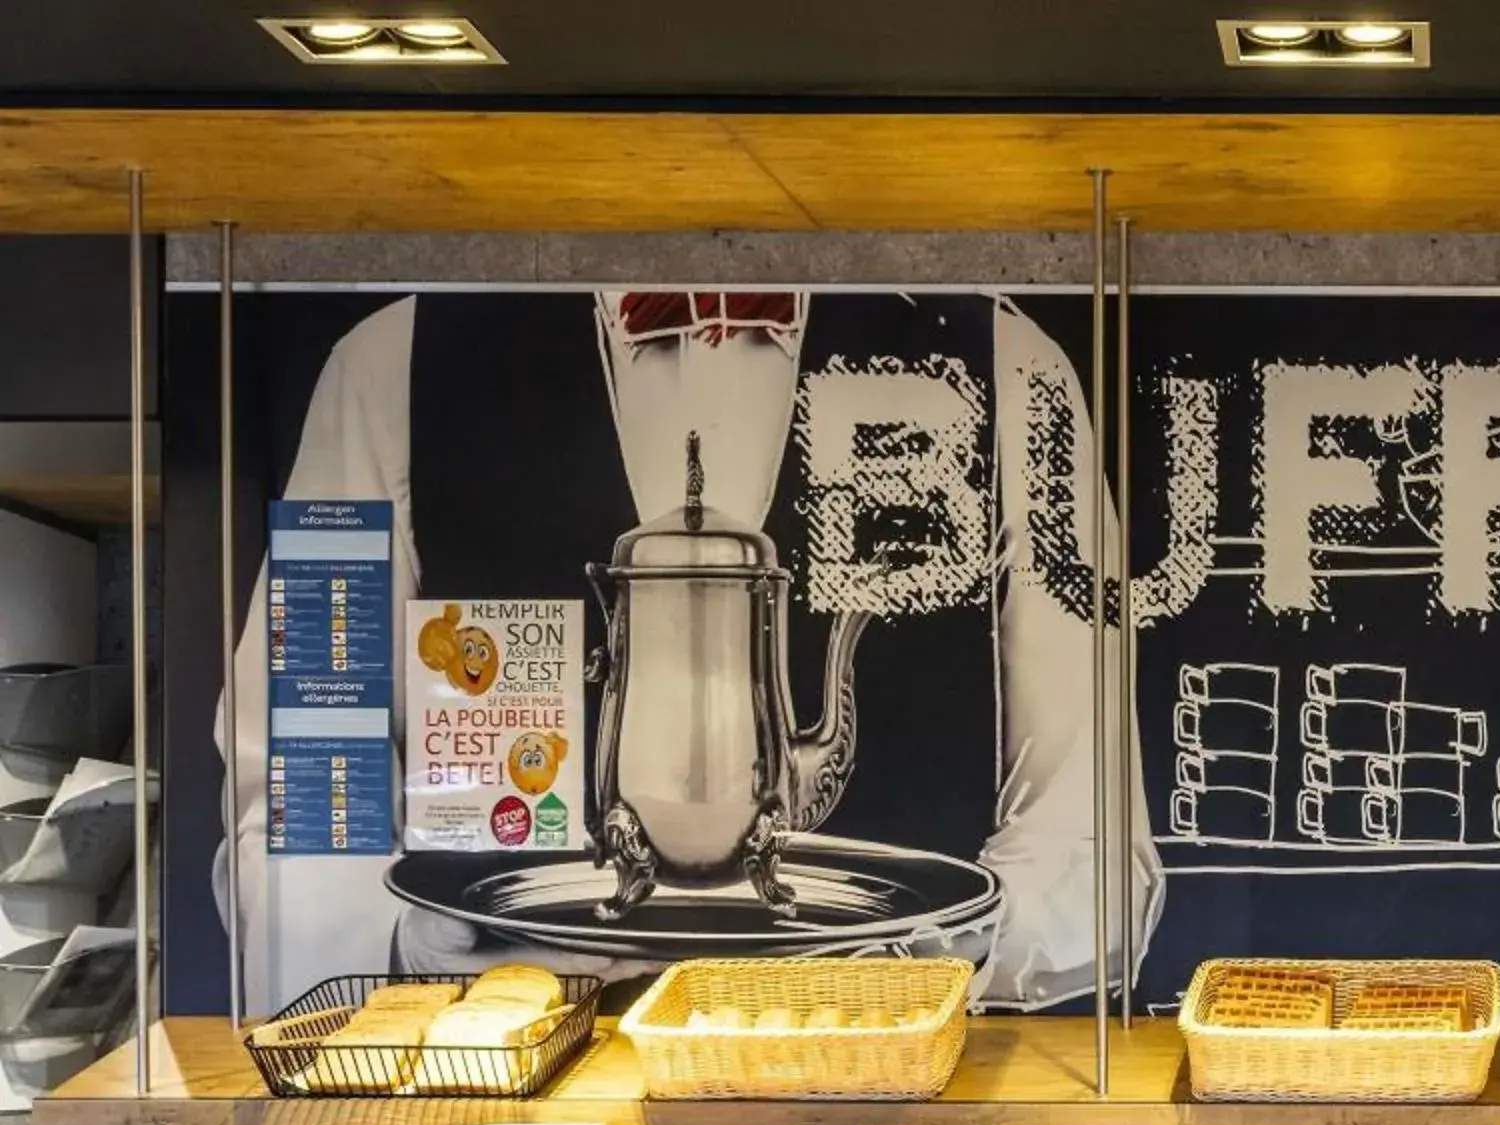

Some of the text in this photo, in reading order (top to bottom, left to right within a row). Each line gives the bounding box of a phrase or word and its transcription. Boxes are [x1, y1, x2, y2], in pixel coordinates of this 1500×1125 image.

[471, 603, 565, 619] REMPLIR
[506, 623, 565, 646] SON
[505, 647, 566, 659] ASSIETTE
[503, 660, 567, 681] C'EST
[296, 681, 365, 691] Informations
[425, 708, 566, 728] LA POUBELLE
[425, 732, 501, 755] C'EST
